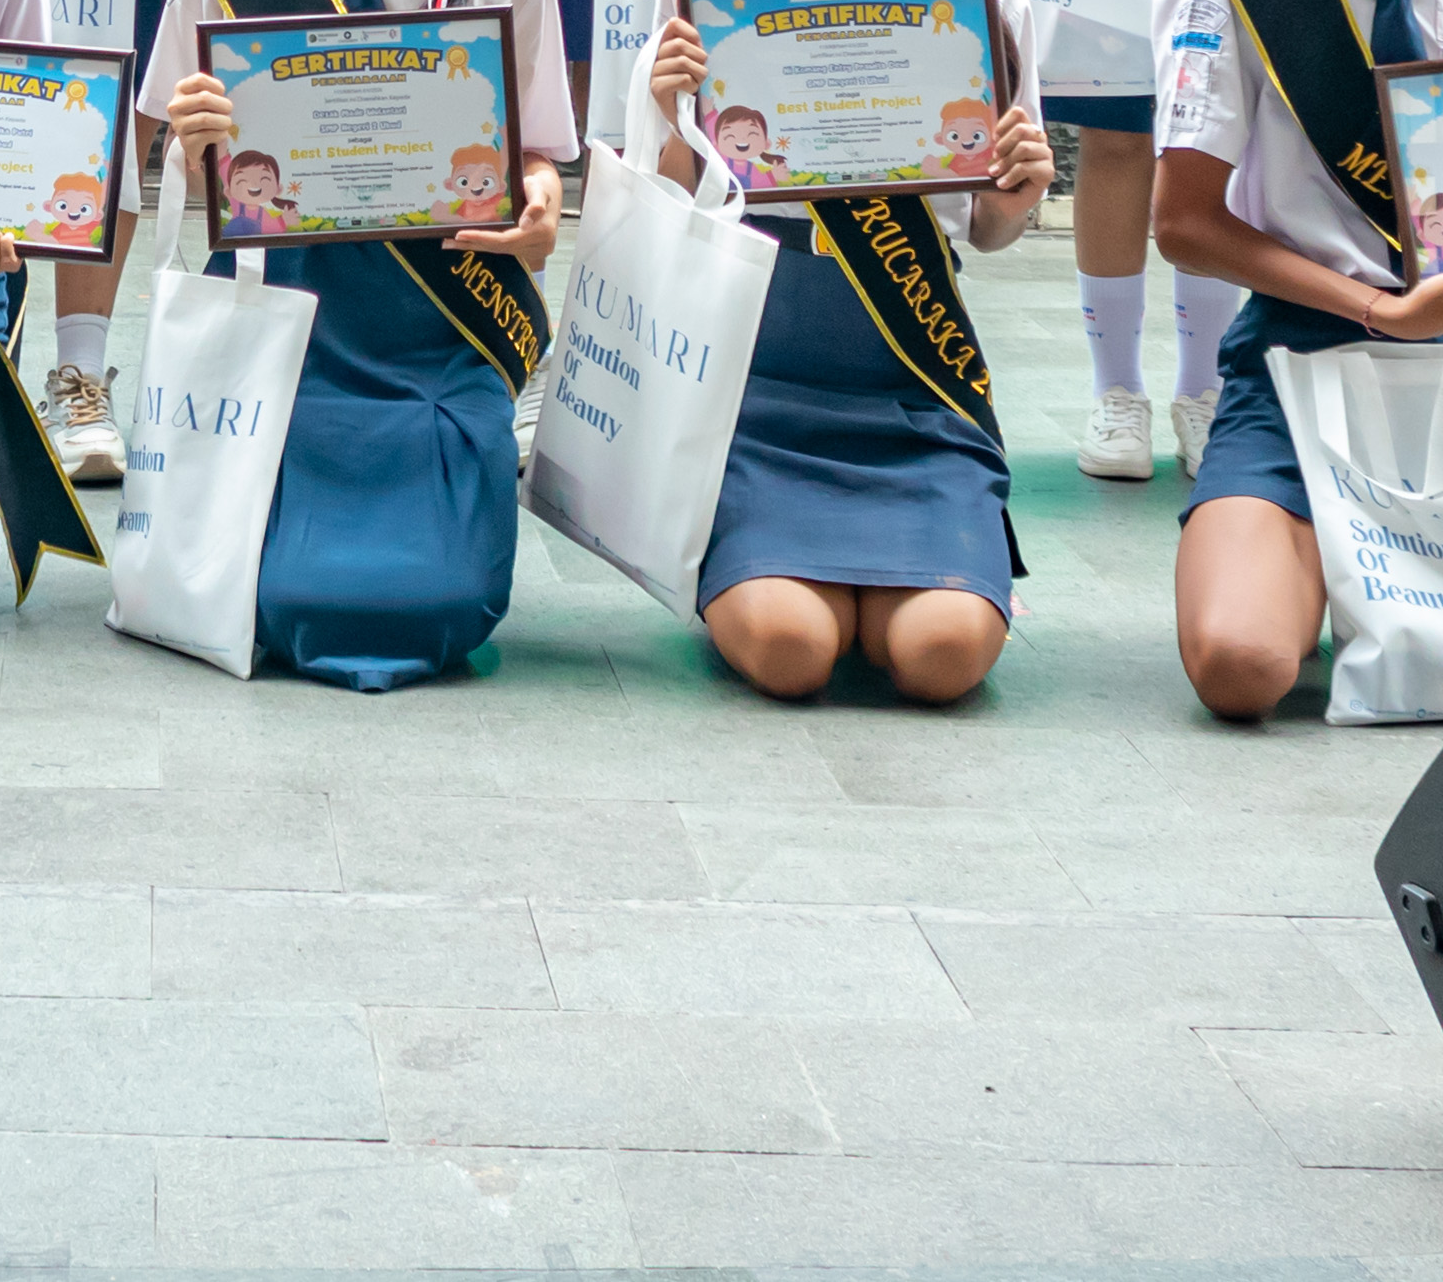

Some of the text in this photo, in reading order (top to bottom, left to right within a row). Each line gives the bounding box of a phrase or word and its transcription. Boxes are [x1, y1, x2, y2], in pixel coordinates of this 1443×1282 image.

[604, 3, 633, 26] Of
[755, 2, 927, 36] SERTIFIKAT
[604, 26, 649, 51] Bea
[271, 47, 442, 81] SERTIFIKAT
[777, 95, 922, 115] Best Student Project
[290, 141, 433, 160] Best Student Project
[573, 263, 712, 385] KUMARI
[563, 352, 582, 380] Of
[567, 320, 641, 391] Solution
[555, 377, 623, 444] Beauty
[1357, 548, 1389, 576] Of
